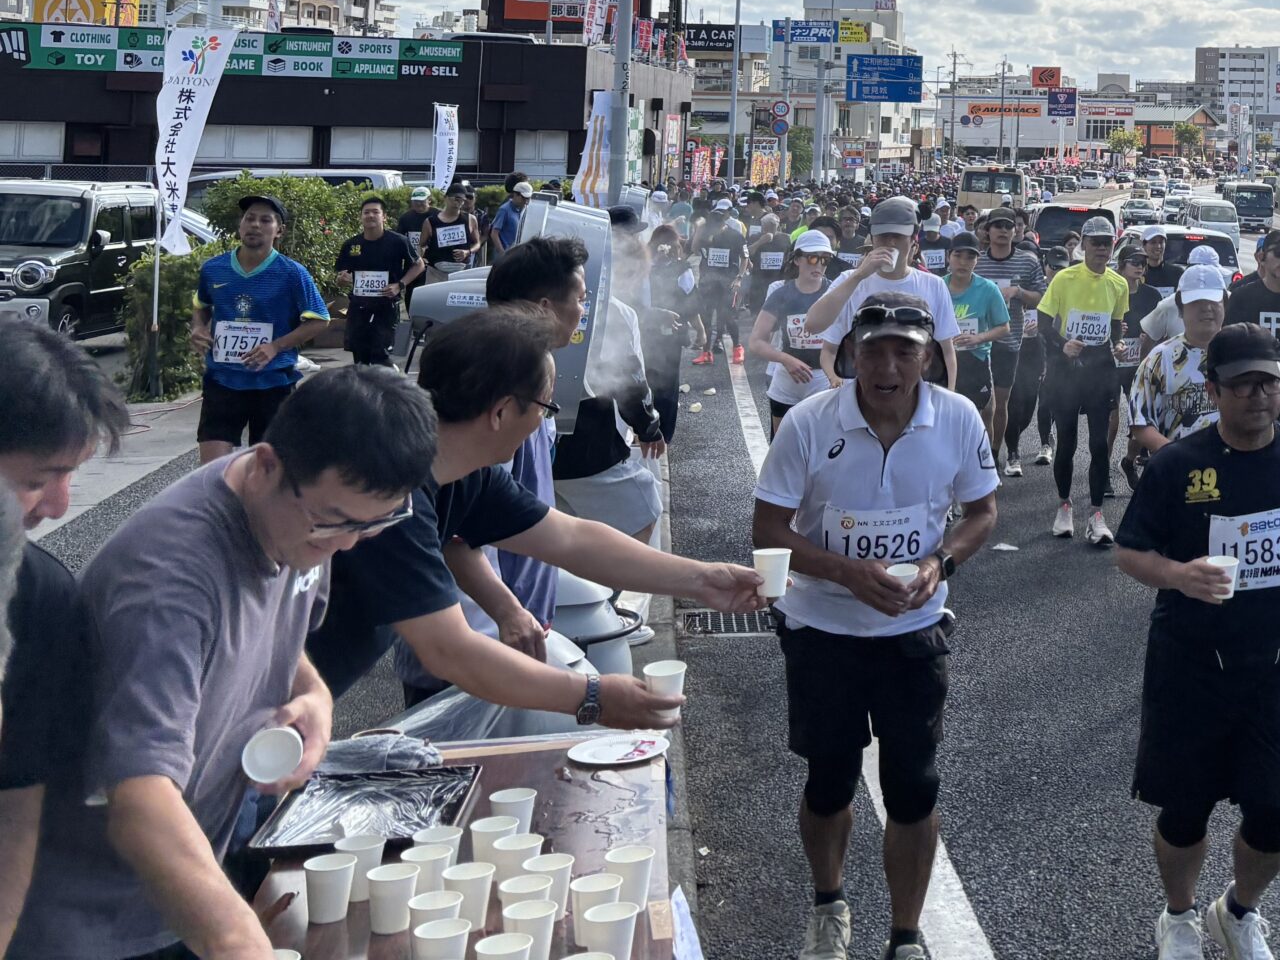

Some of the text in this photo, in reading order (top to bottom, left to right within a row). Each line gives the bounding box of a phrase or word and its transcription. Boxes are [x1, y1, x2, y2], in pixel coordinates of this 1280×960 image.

[70, 32, 111, 44] CLOTHING
[146, 34, 165, 44] BRA
[711, 29, 736, 40] CAR
[234, 37, 258, 49] USIC
[286, 39, 331, 52] INSTRUMENT
[358, 43, 393, 54] SPORTS
[418, 46, 461, 57] AMUSEMENT
[75, 53, 105, 65] TOY
[151, 56, 164, 66] CA
[293, 61, 323, 72] BOOK
[354, 63, 395, 75] APPLIANCE
[401, 64, 459, 77] BUY SELL
[776, 105, 786, 114] 50
[686, 140, 697, 152] P
[355, 279, 387, 289] L24839
[1067, 322, 1108, 336] J15034
[214, 334, 270, 350] K17576
[1187, 467, 1218, 493] 39
